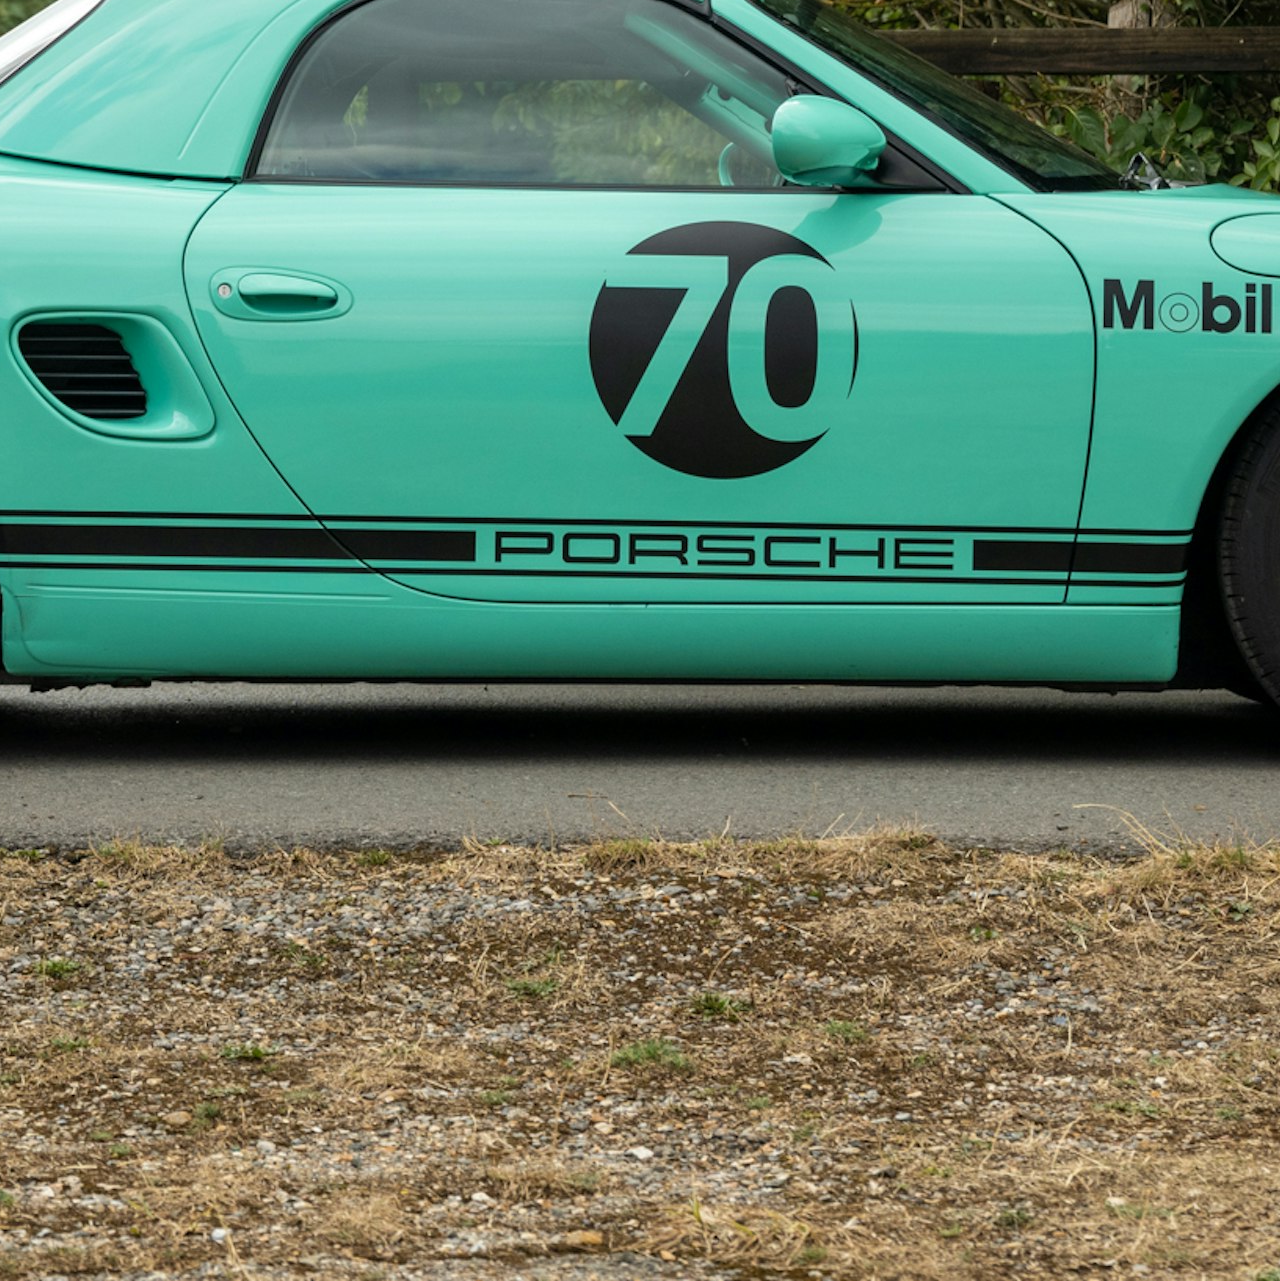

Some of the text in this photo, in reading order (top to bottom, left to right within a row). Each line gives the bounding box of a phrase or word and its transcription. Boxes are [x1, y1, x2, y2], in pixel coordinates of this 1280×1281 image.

[1103, 279, 1272, 333] Mobil
[603, 254, 852, 443] 70
[494, 531, 955, 570] PORSCHE
